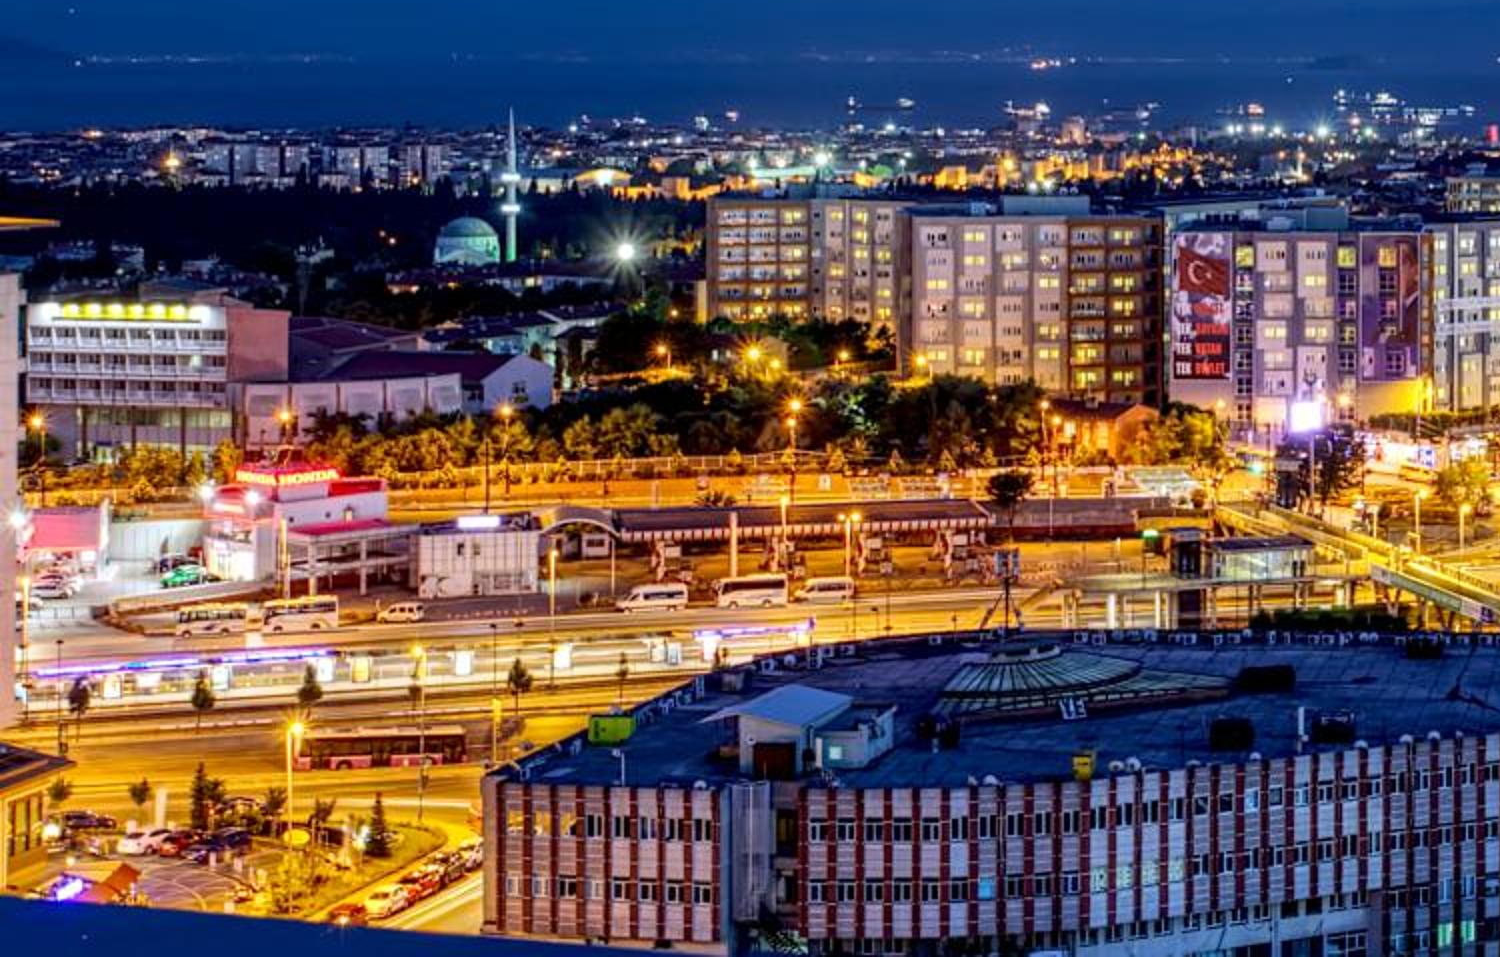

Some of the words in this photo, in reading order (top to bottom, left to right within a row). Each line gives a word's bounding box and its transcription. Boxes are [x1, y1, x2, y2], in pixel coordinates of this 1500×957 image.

[1175, 342, 1192, 355] TEK
[1176, 362, 1192, 376] TEK
[278, 468, 340, 485] HONDA
